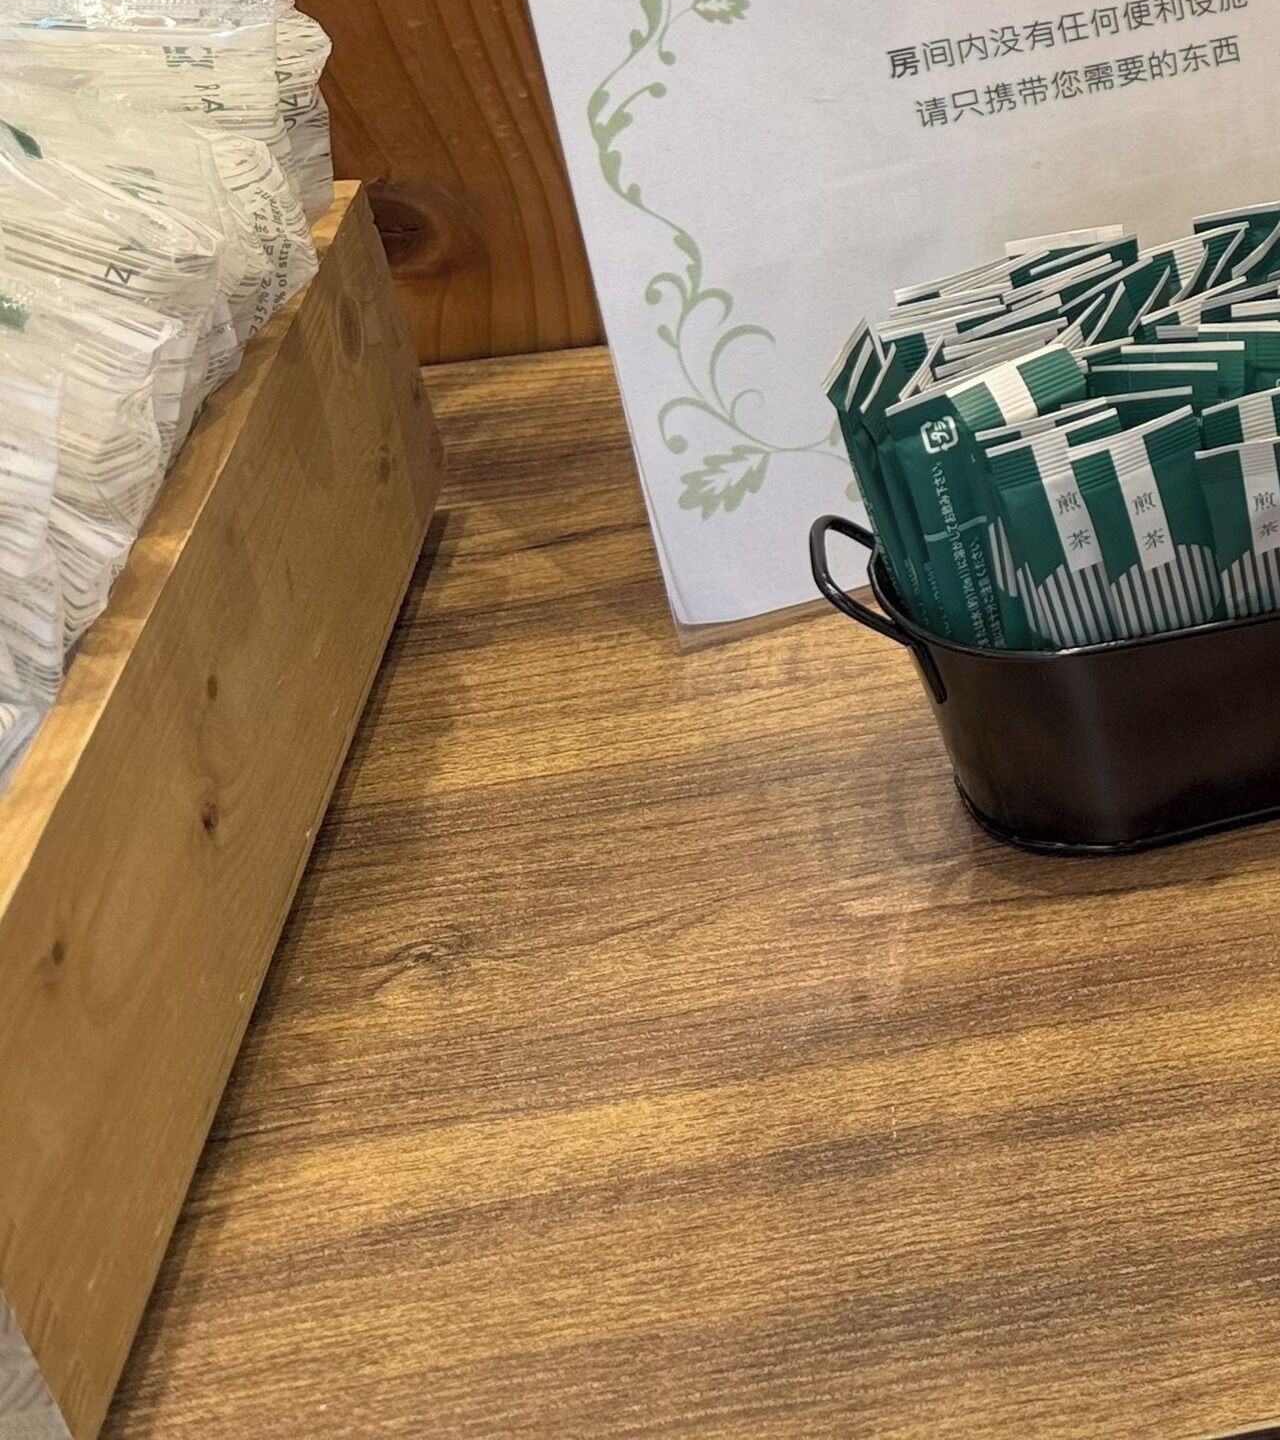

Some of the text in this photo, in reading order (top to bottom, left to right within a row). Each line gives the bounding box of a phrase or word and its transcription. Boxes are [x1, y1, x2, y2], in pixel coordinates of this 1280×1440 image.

[914, 35, 1242, 129] 请只携带您需要的东西
